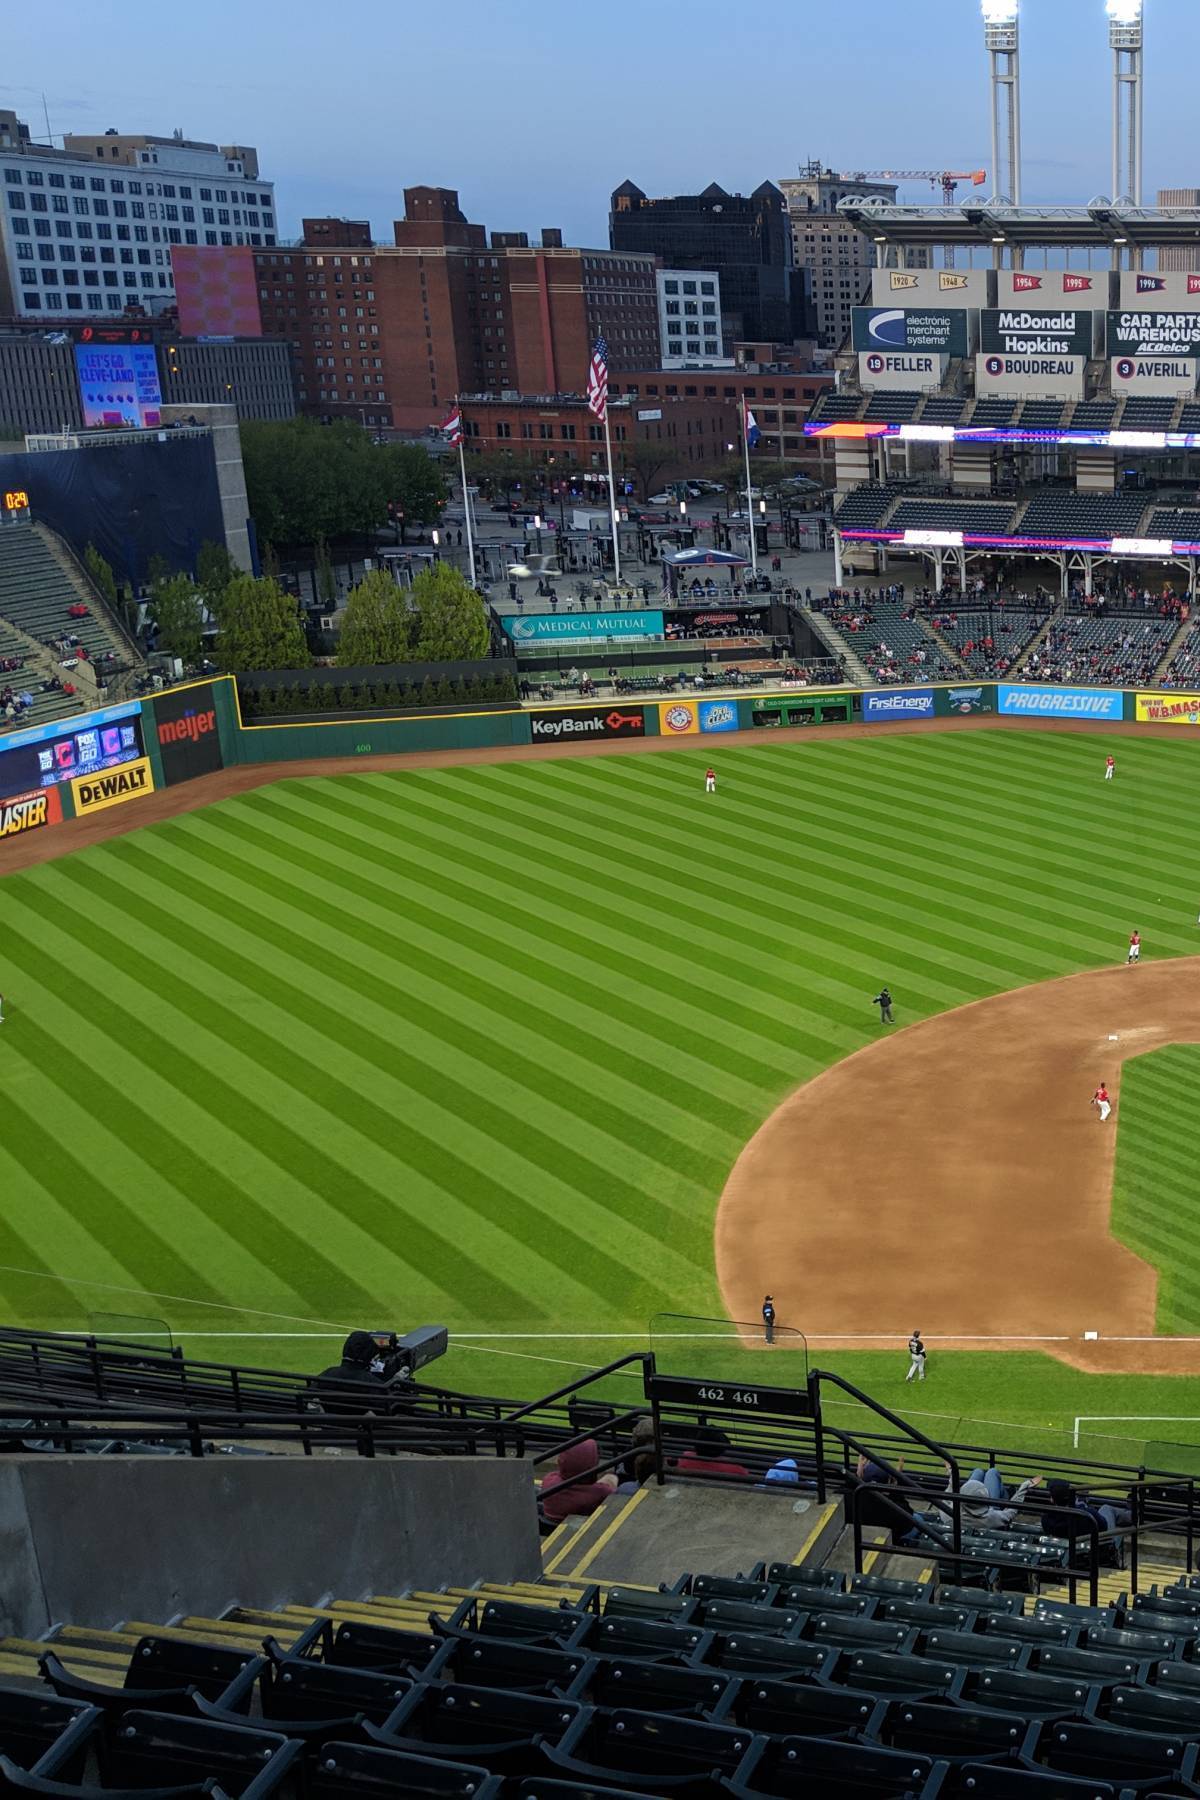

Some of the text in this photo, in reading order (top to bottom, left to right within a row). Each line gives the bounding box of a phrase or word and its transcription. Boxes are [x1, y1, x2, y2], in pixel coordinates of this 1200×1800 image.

[1065, 277, 1083, 288] 1995
[1139, 278, 1156, 289] 1996
[906, 315, 951, 326] electronic
[998, 312, 1076, 331] McDonald
[1120, 313, 1152, 328] CAR
[906, 326, 950, 335] merchant
[906, 337, 946, 346] systems
[1005, 336, 1069, 355] Hopkins
[1136, 342, 1191, 352] ACDelco
[870, 357, 932, 372] 19 FELLER
[991, 360, 1074, 376] 5 BOUDREAU
[1121, 362, 1191, 377] 3 AVERILL
[868, 695, 933, 712] FirstEnergy
[1004, 692, 1114, 713] PROGRESSIVE
[158, 709, 215, 744] meijer
[532, 716, 605, 735] KeyBank
[78, 732, 97, 747] FOX
[698, 1387, 759, 1405] 462 461
